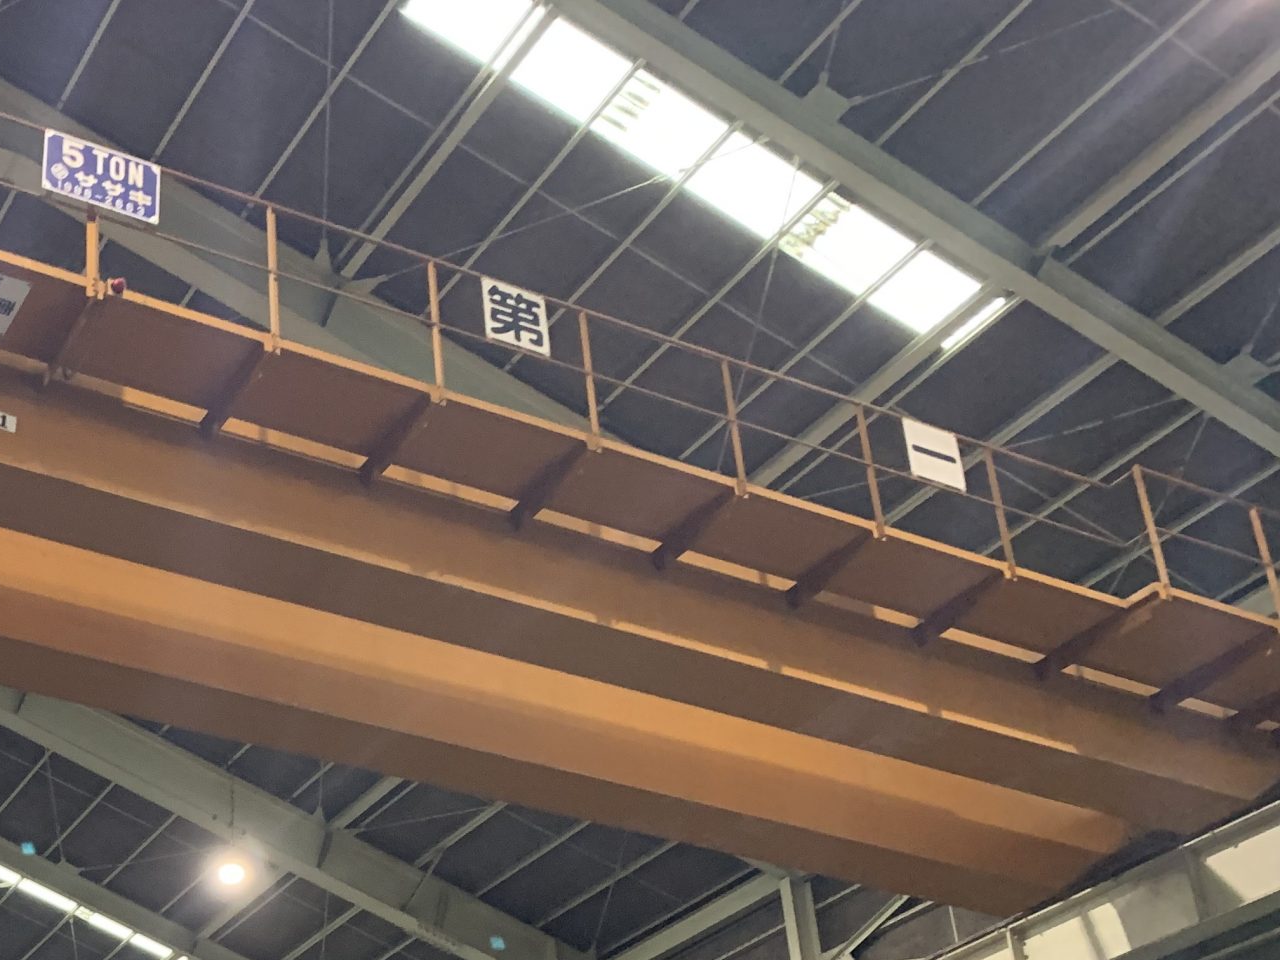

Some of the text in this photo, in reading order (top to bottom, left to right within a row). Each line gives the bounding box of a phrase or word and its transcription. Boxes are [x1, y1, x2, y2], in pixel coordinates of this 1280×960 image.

[62, 138, 144, 188] 5 TON
[74, 171, 152, 206] ササキ
[488, 286, 546, 347] 第
[912, 443, 958, 463] 一
